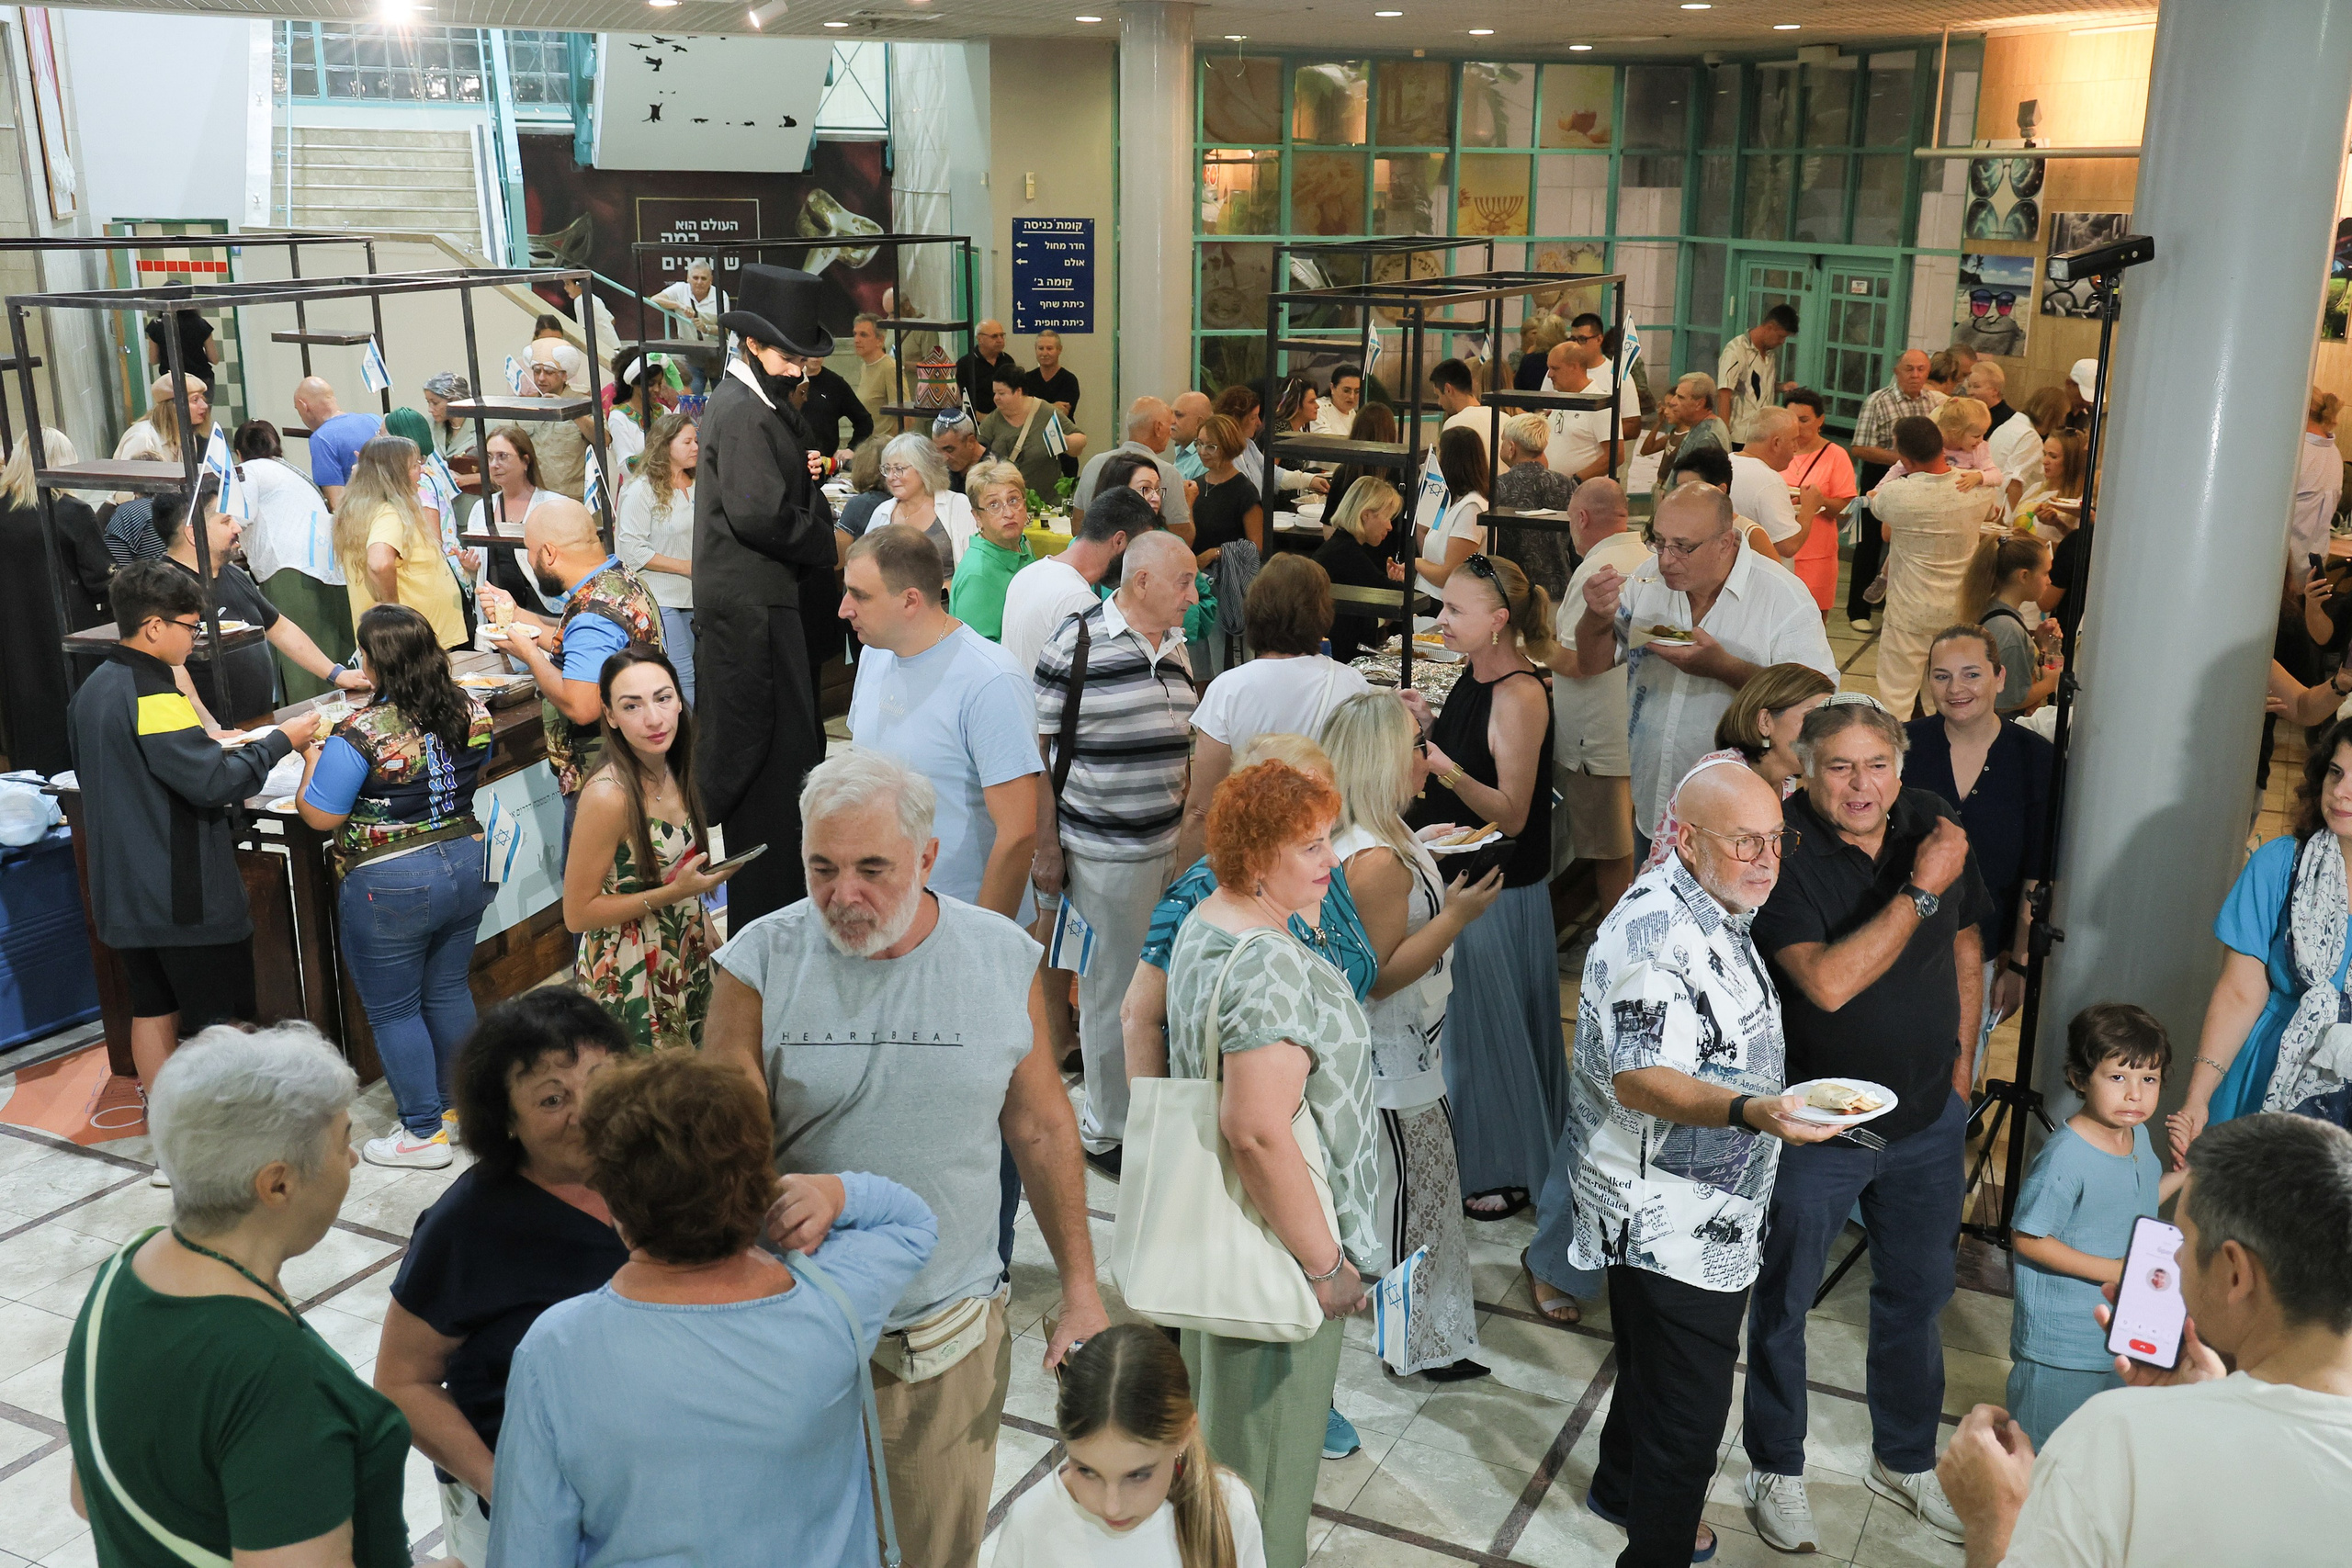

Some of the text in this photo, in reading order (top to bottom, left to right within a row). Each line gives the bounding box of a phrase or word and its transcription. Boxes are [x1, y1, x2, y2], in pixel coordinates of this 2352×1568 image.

[675, 218, 739, 231] העולם הוא
[1023, 220, 1083, 231] קומת כניסה
[1045, 241, 1067, 250] מחול
[1064, 257, 1085, 266] אולם
[1046, 278, 1073, 288] קומה
[1039, 300, 1085, 310] כיתת שחף
[1035, 319, 1060, 327] חופית
[782, 1031, 961, 1043] HEARTBEAT
[1576, 1102, 1600, 1127] MOON
[1583, 1176, 1621, 1198] ex-rocker
[1577, 1182, 1630, 1213] premeditated
[1581, 1197, 1617, 1221] execution
